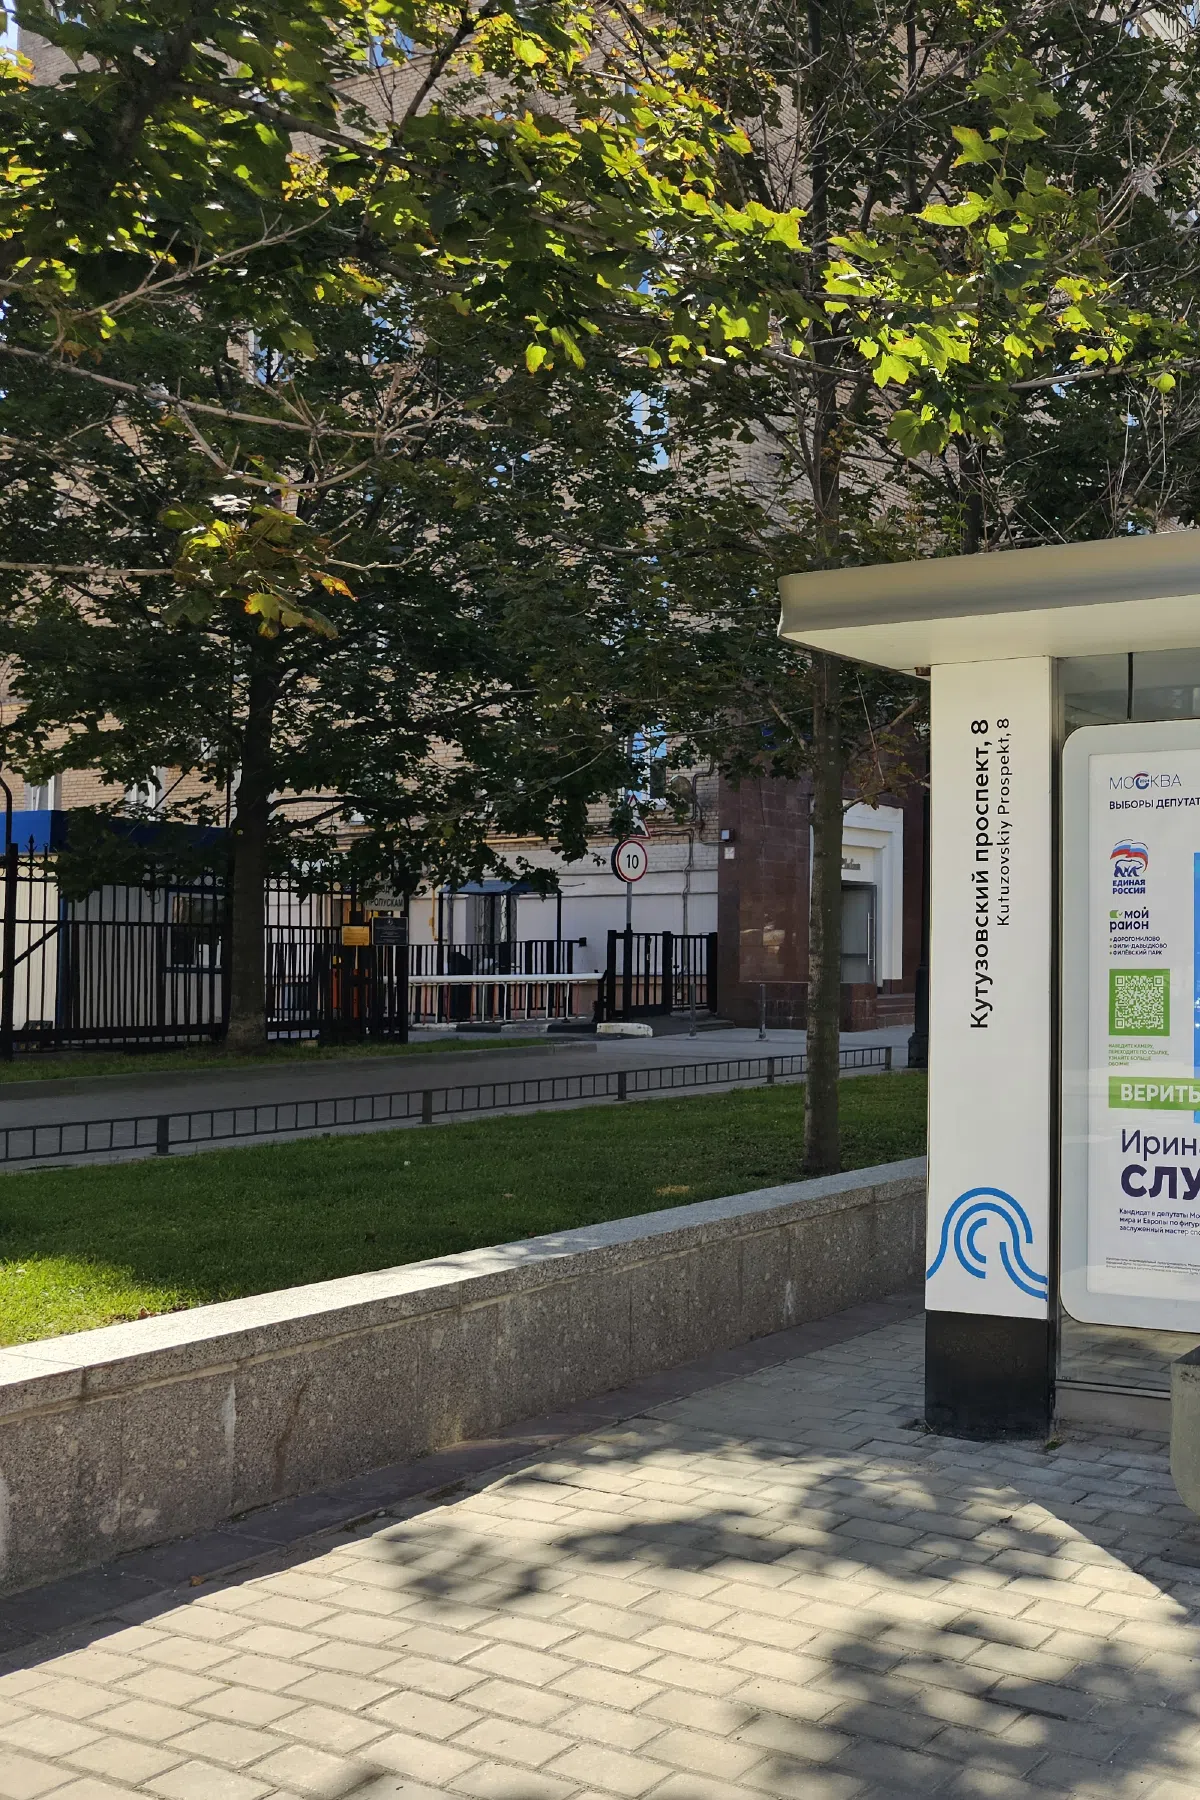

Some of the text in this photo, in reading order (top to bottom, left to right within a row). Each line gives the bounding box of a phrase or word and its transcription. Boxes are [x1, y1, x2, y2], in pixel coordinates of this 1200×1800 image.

[1109, 770, 1182, 790] МОСКВА
[1109, 799, 1154, 811] ВЫБОРЫ
[996, 717, 1013, 926] Kutuzovskiy Prospekt, 8
[626, 854, 639, 870] 10
[970, 718, 993, 1029] Кутузовский проспект, 8
[1112, 879, 1146, 887] ЕДИНАЯ
[1124, 906, 1149, 919] мой
[1119, 1208, 1150, 1217] Кандидат
[1156, 1211, 1188, 1219] депутаты
[1119, 1225, 1164, 1234] заслуженный
